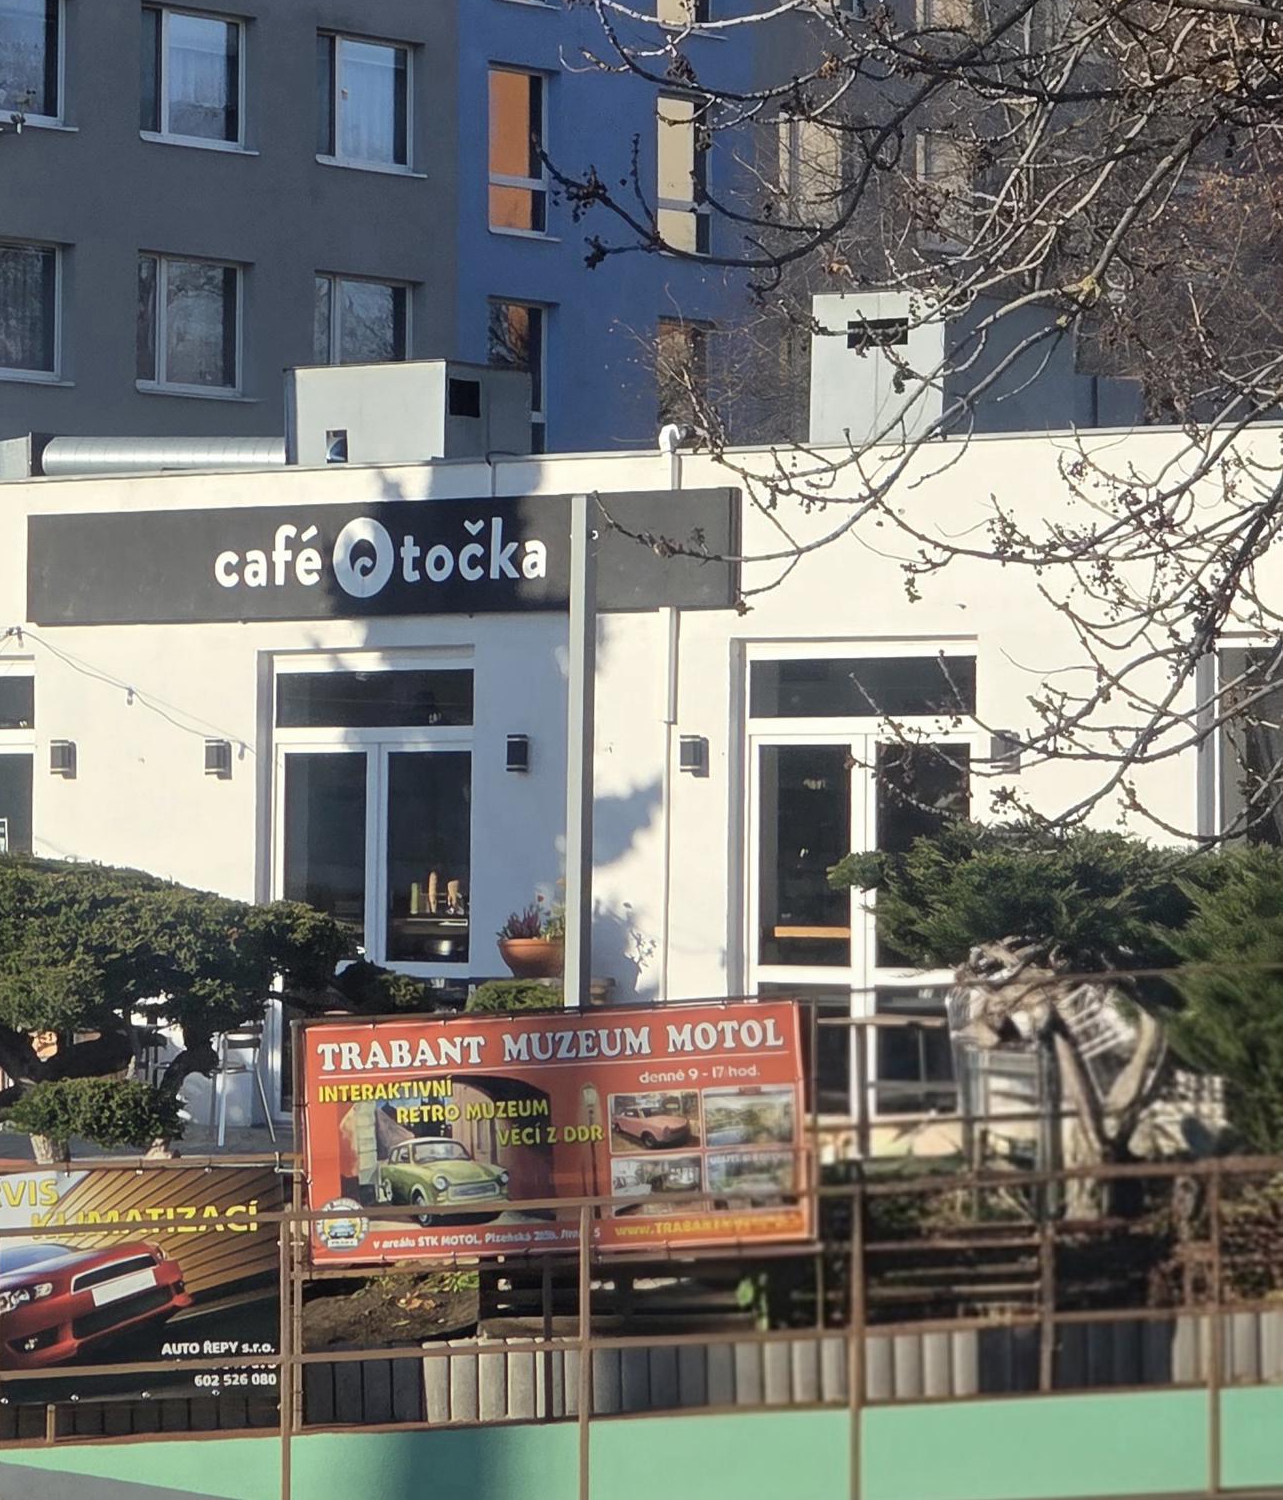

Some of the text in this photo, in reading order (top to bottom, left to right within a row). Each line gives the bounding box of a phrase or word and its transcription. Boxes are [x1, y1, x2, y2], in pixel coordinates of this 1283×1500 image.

[214, 524, 322, 587] café
[317, 1018, 784, 1071] TRABANT MUZEUM MOTOL
[688, 1068, 699, 1082] 9
[712, 1066, 725, 1079] 17
[728, 1064, 762, 1078] hod.
[318, 1075, 454, 1103] INTERAKTIVNÍ
[397, 1099, 549, 1125] RETRO MUZEUM
[497, 1122, 604, 1147] VĚCÍ Z DDR
[418, 1235, 439, 1247] STK
[161, 1340, 275, 1355] AUTO ŘEPY s.r.o.
[194, 1373, 277, 1387] 602 526 080
